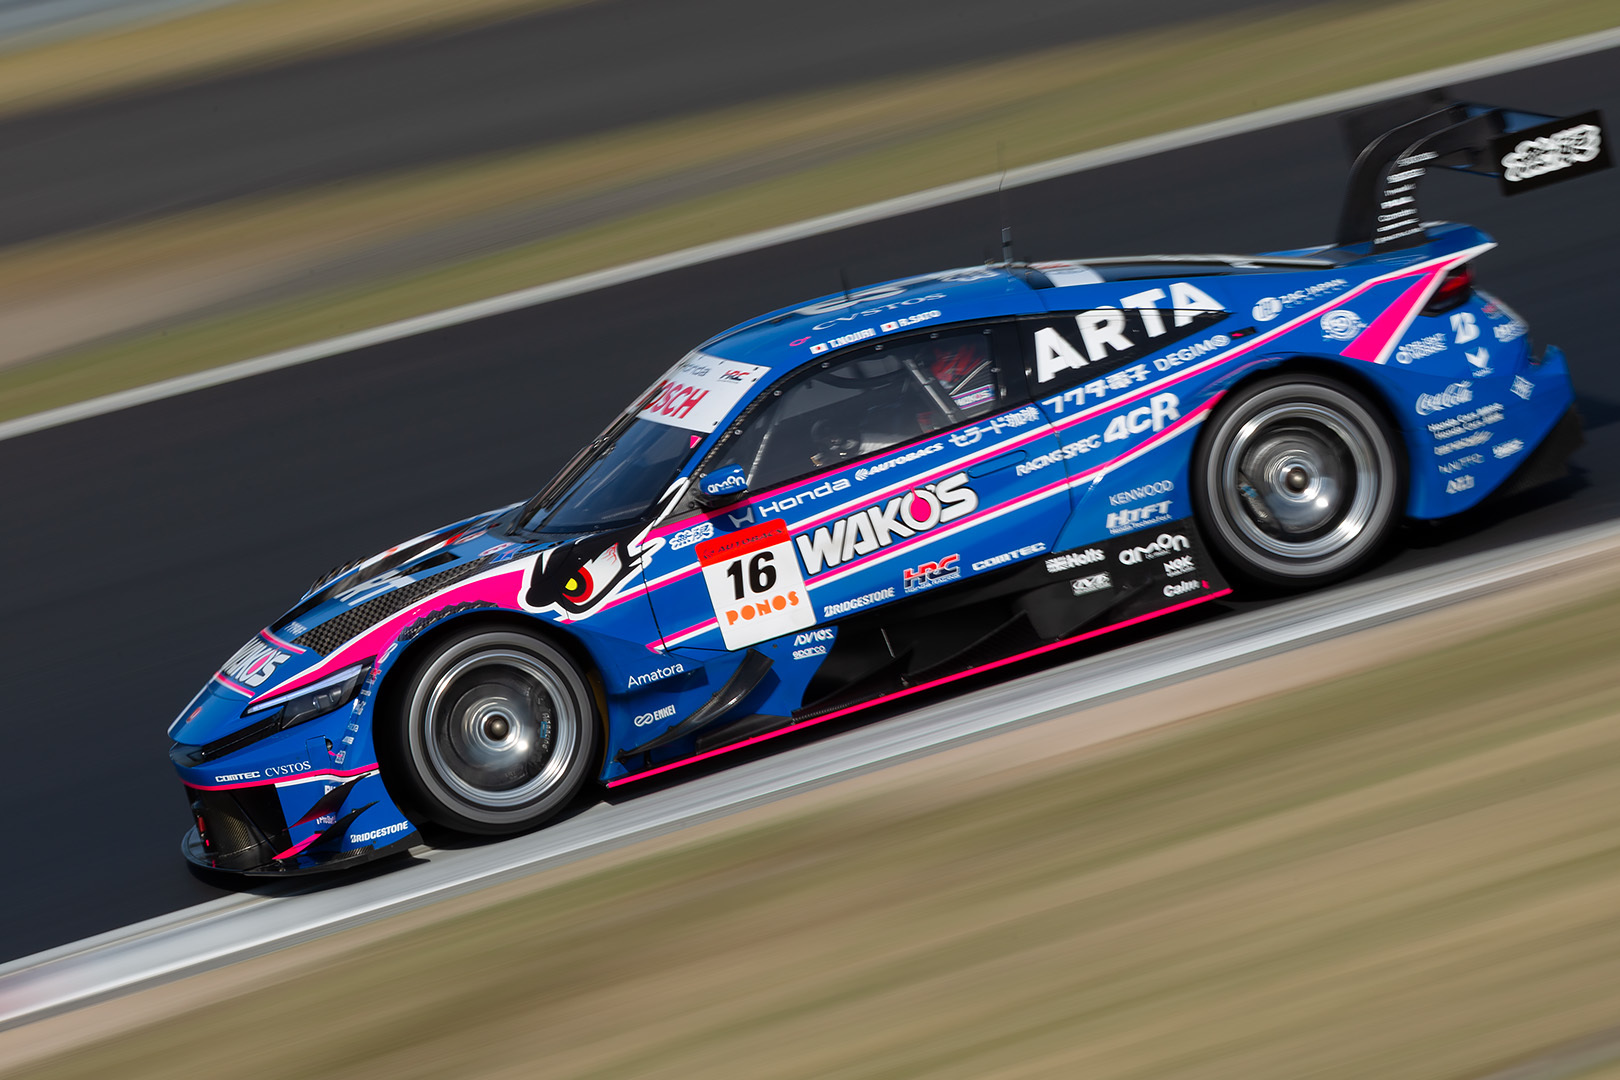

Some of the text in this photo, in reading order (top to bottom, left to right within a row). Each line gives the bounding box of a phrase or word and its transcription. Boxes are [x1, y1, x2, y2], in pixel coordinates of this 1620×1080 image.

[1034, 282, 1226, 383] ARTA
[636, 379, 709, 419] OSCH
[1103, 392, 1181, 443] 4CR
[867, 442, 945, 476] AUTOBACS
[759, 477, 851, 517] Honda
[1109, 480, 1174, 506] KENWOOD
[971, 542, 1047, 571] COMTEC
[1119, 533, 1190, 565] amon
[726, 551, 777, 600] 16
[903, 553, 961, 589] HRC
[725, 591, 800, 625] PONOS
[824, 587, 895, 618] BRIDGESTONE
[627, 663, 684, 688] Amatora
[653, 704, 676, 722] ENKEI
[215, 761, 311, 783] COMTEC CVSTOS
[350, 820, 409, 843] BRIDGESTONE
